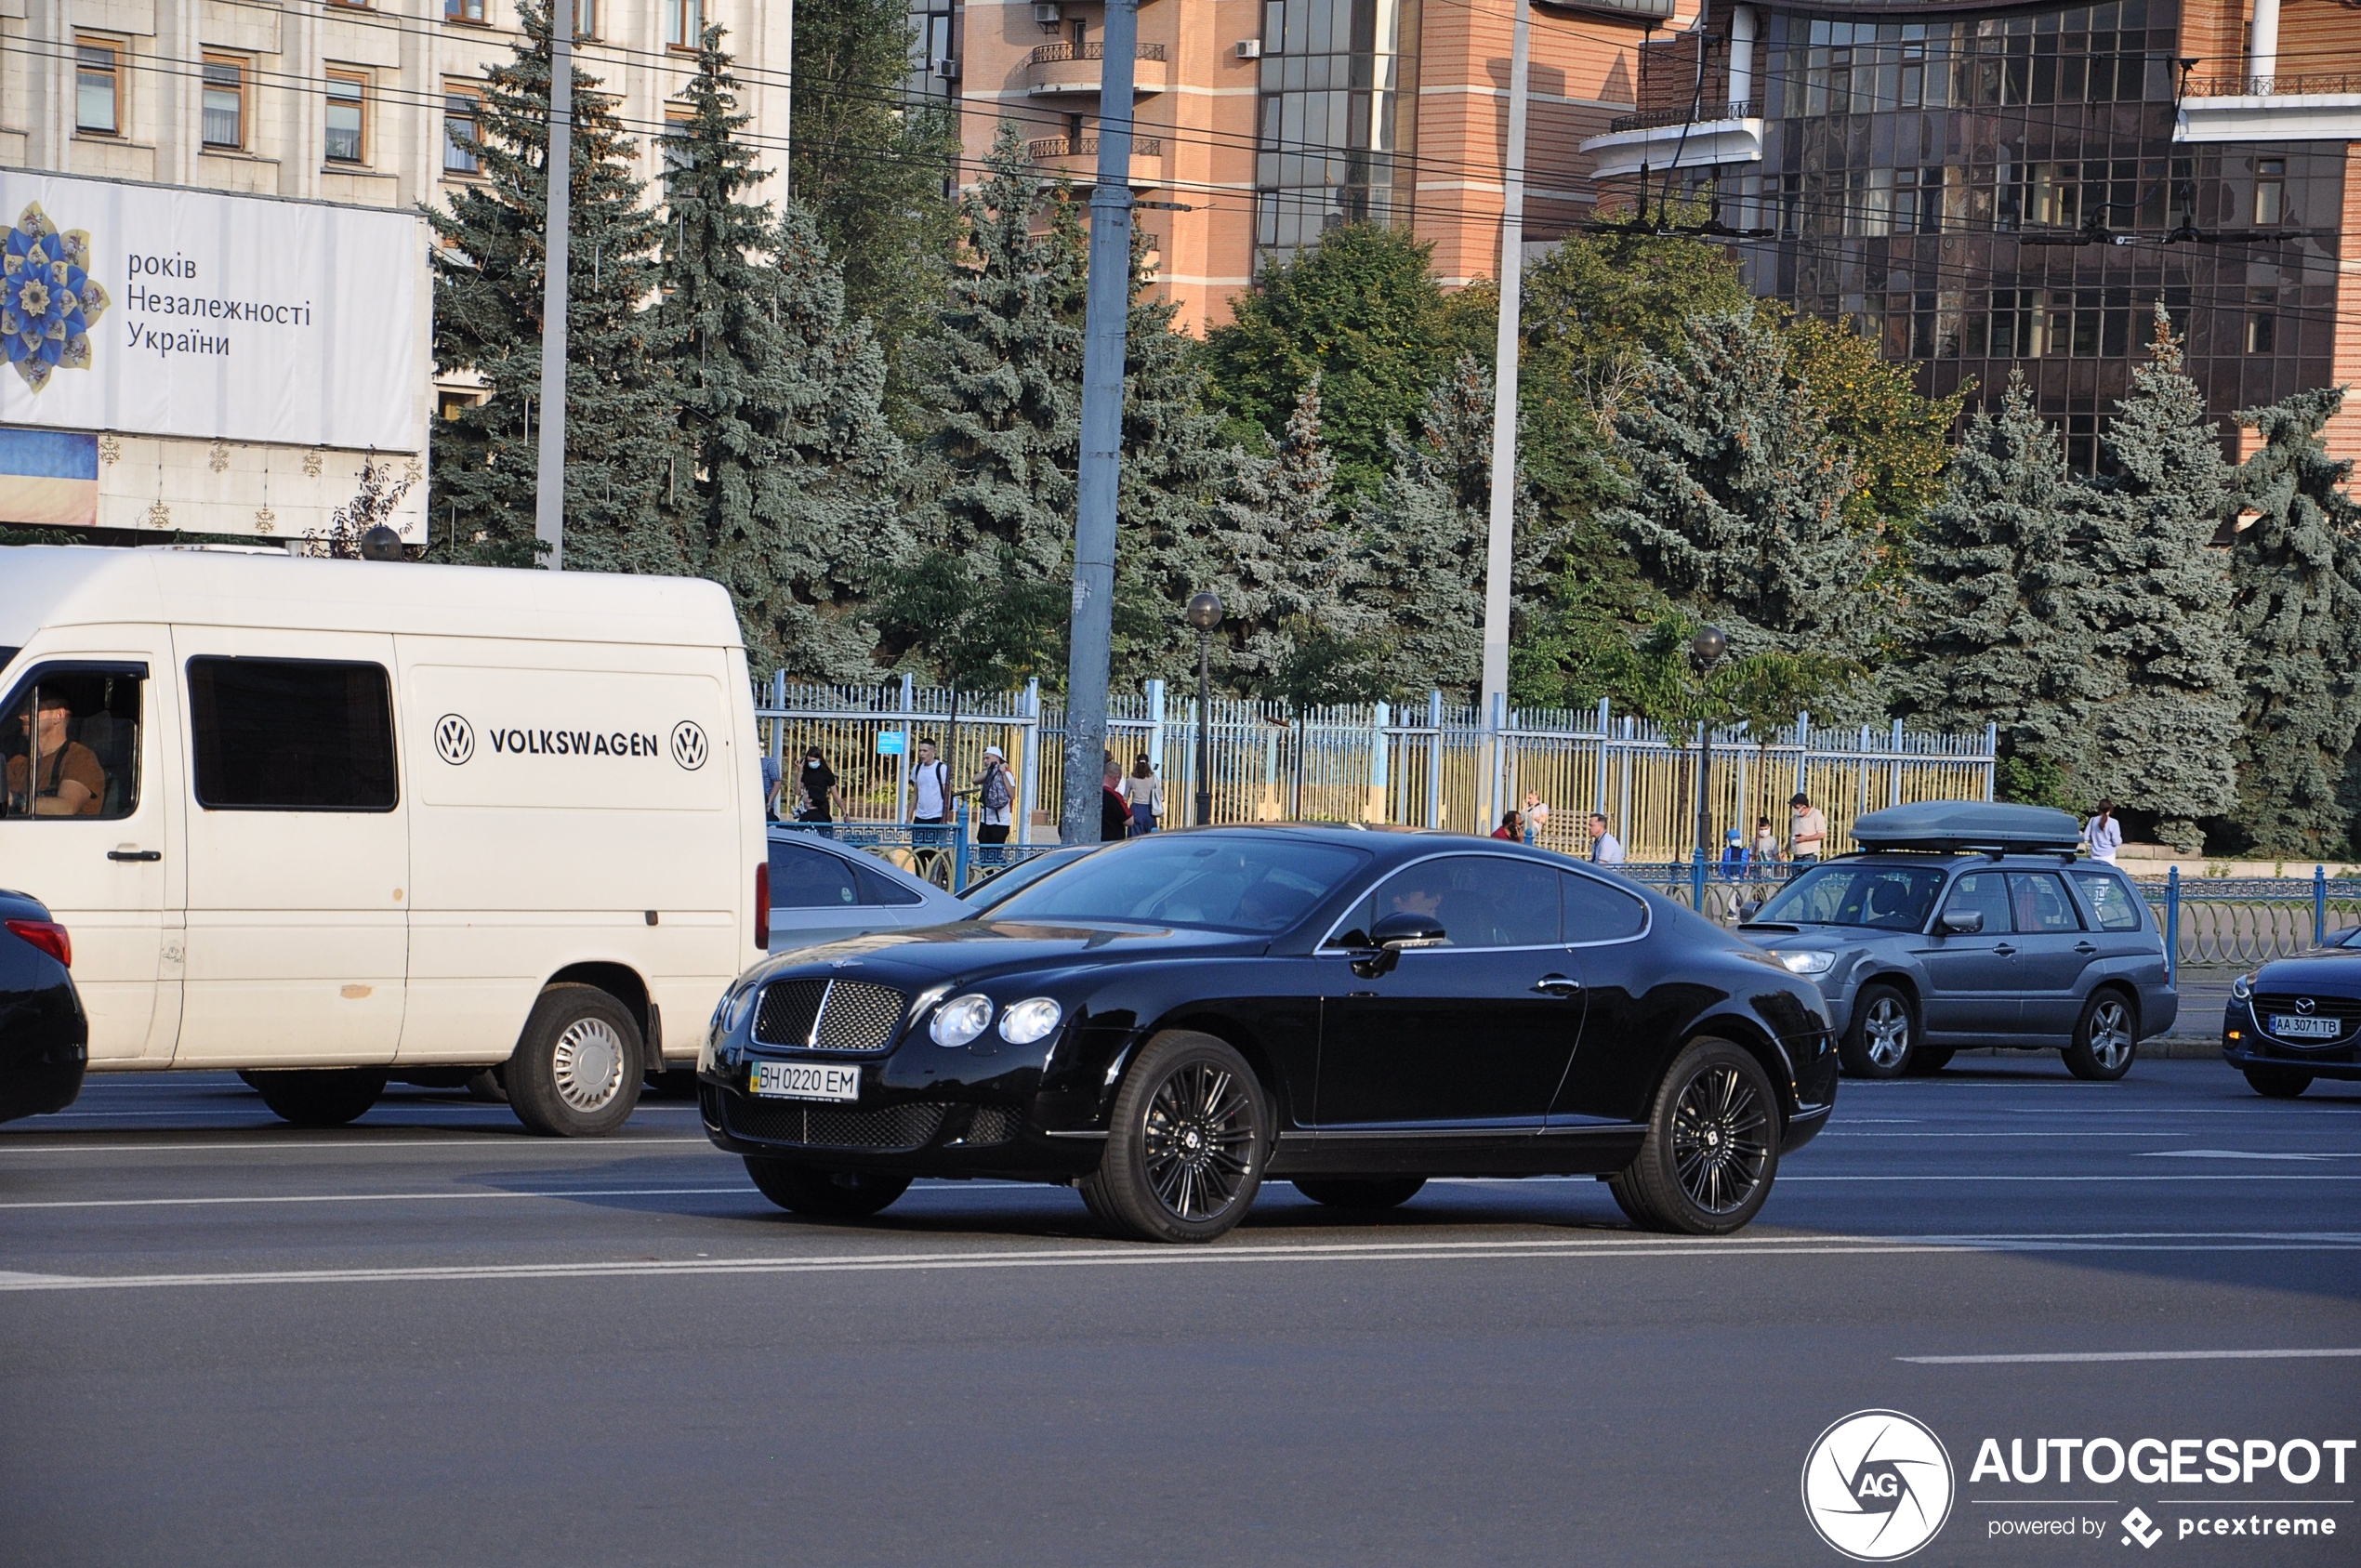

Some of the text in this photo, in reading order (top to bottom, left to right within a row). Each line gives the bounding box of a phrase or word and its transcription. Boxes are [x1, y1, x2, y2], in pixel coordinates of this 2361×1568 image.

[129, 252, 196, 280] років
[128, 284, 310, 326] Незалежності
[128, 322, 230, 358] України
[490, 730, 658, 757] VOLKSWAGEN
[2276, 1018, 2337, 1033] AA 3071 TB
[759, 1066, 854, 1094] BH 0220 EM
